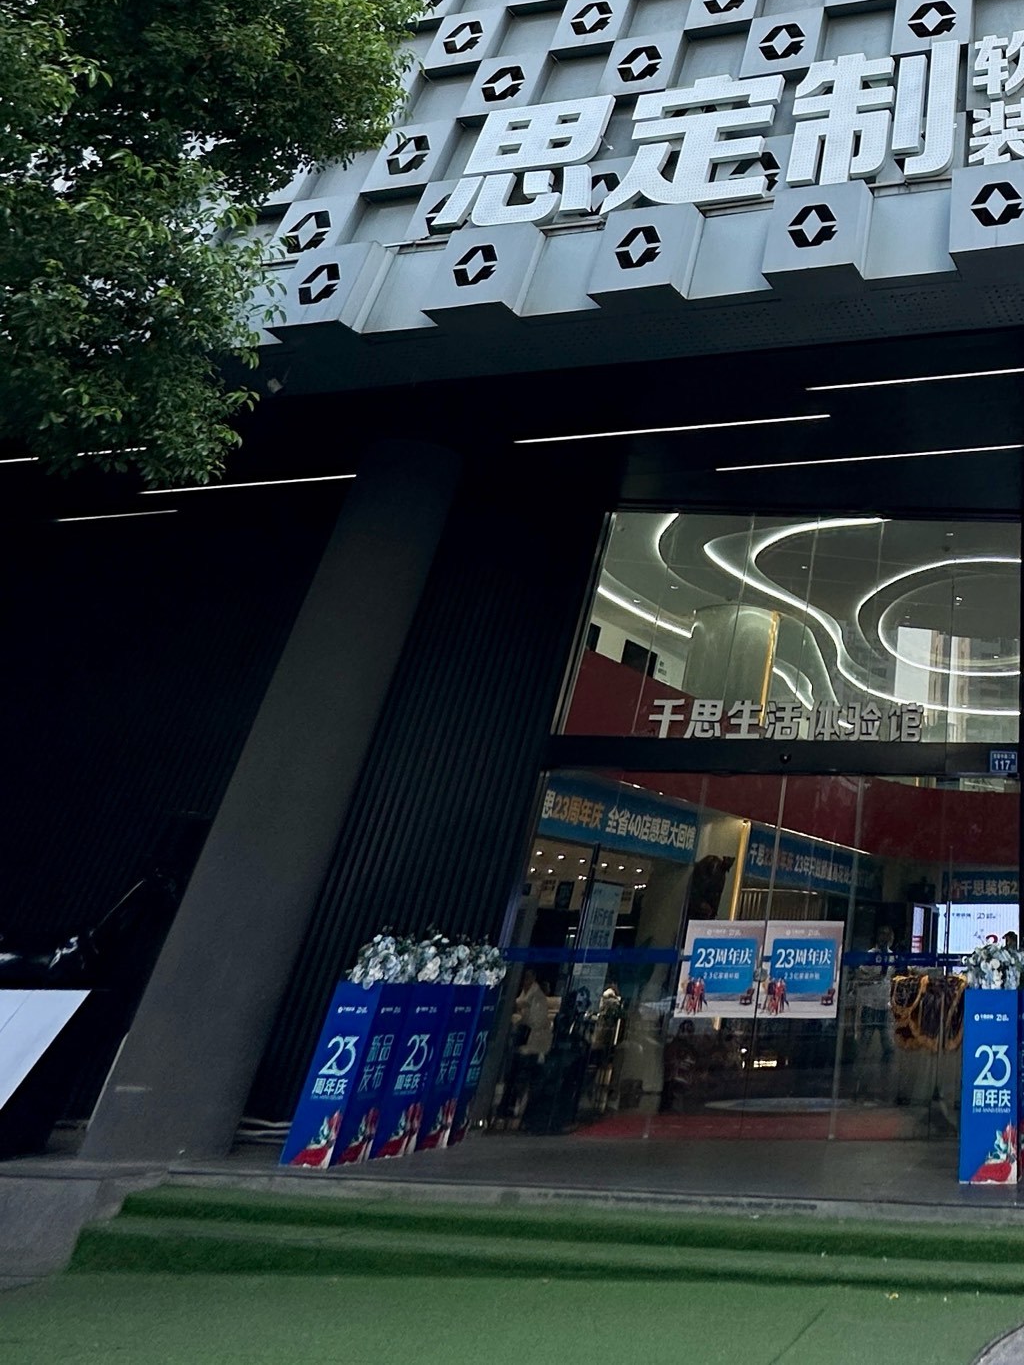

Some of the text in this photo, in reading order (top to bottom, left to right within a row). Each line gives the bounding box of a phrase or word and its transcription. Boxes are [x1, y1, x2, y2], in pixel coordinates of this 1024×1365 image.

[430, 39, 960, 227] 思定制
[648, 698, 925, 743] 千思生活体验馆
[994, 759, 1011, 771] 117
[695, 947, 752, 968] 23周年庆
[775, 948, 832, 969] 23周年庆
[318, 1035, 360, 1076] 23
[400, 1034, 431, 1072] 23
[973, 1044, 1011, 1087] 23
[311, 1077, 349, 1096] 周年庆
[394, 1073, 422, 1091] 周年庆
[973, 1088, 1011, 1107] 周年庆
